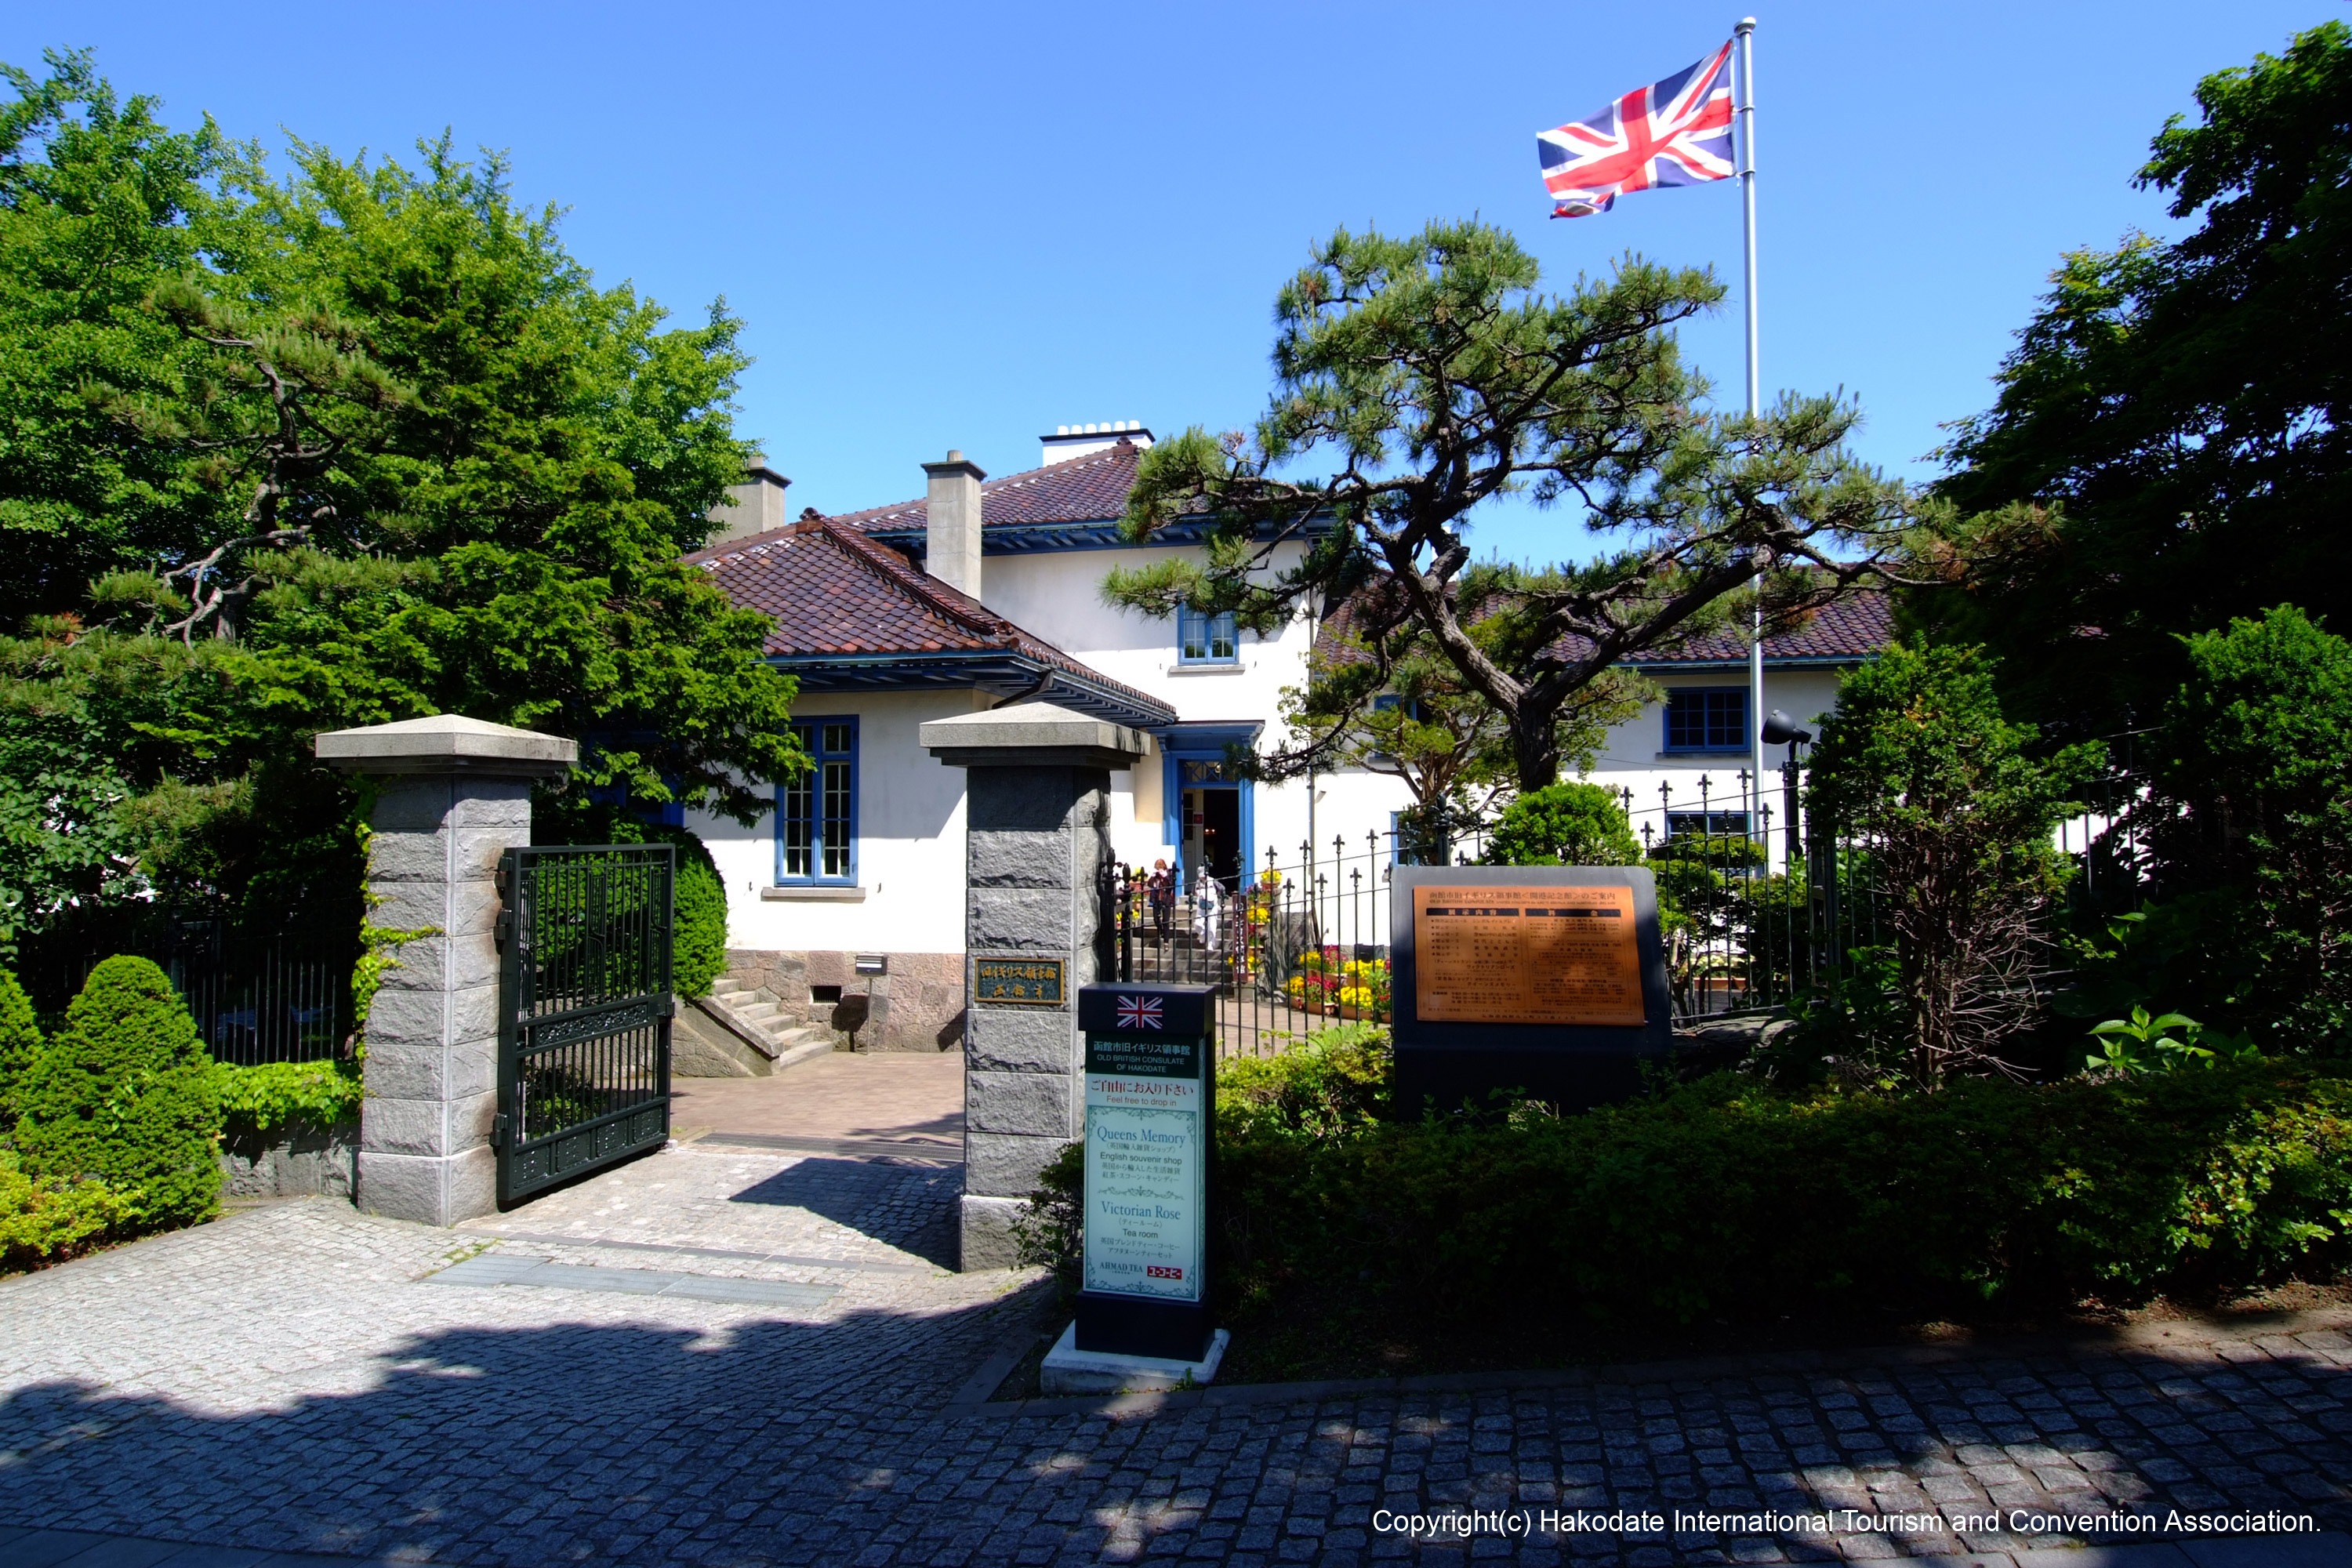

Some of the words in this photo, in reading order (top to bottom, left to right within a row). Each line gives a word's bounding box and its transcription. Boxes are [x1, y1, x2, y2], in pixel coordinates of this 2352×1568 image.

[1094, 1040, 1190, 1055] 函館市旧イギリス領事館
[1112, 1054, 1141, 1063] BRITISH
[1142, 1056, 1185, 1065] CONSULATE
[1128, 1065, 1167, 1073] HAKODATE
[1091, 1080, 1194, 1096] ご自由にお入り下さい
[1124, 1096, 1140, 1105] free
[1141, 1097, 1149, 1105] to
[1150, 1098, 1168, 1107] drop
[1097, 1125, 1138, 1142] Queens
[1141, 1129, 1186, 1149] Memory
[1100, 1152, 1128, 1162] English
[1129, 1155, 1163, 1163] souvenir
[1163, 1156, 1183, 1166] shop
[1101, 1200, 1152, 1218] Victorian
[1154, 1204, 1181, 1221] Rose
[1123, 1228, 1138, 1238] Tea
[1138, 1231, 1159, 1240] room
[1099, 1261, 1127, 1271] AHMAD
[1129, 1264, 1143, 1273] TEA
